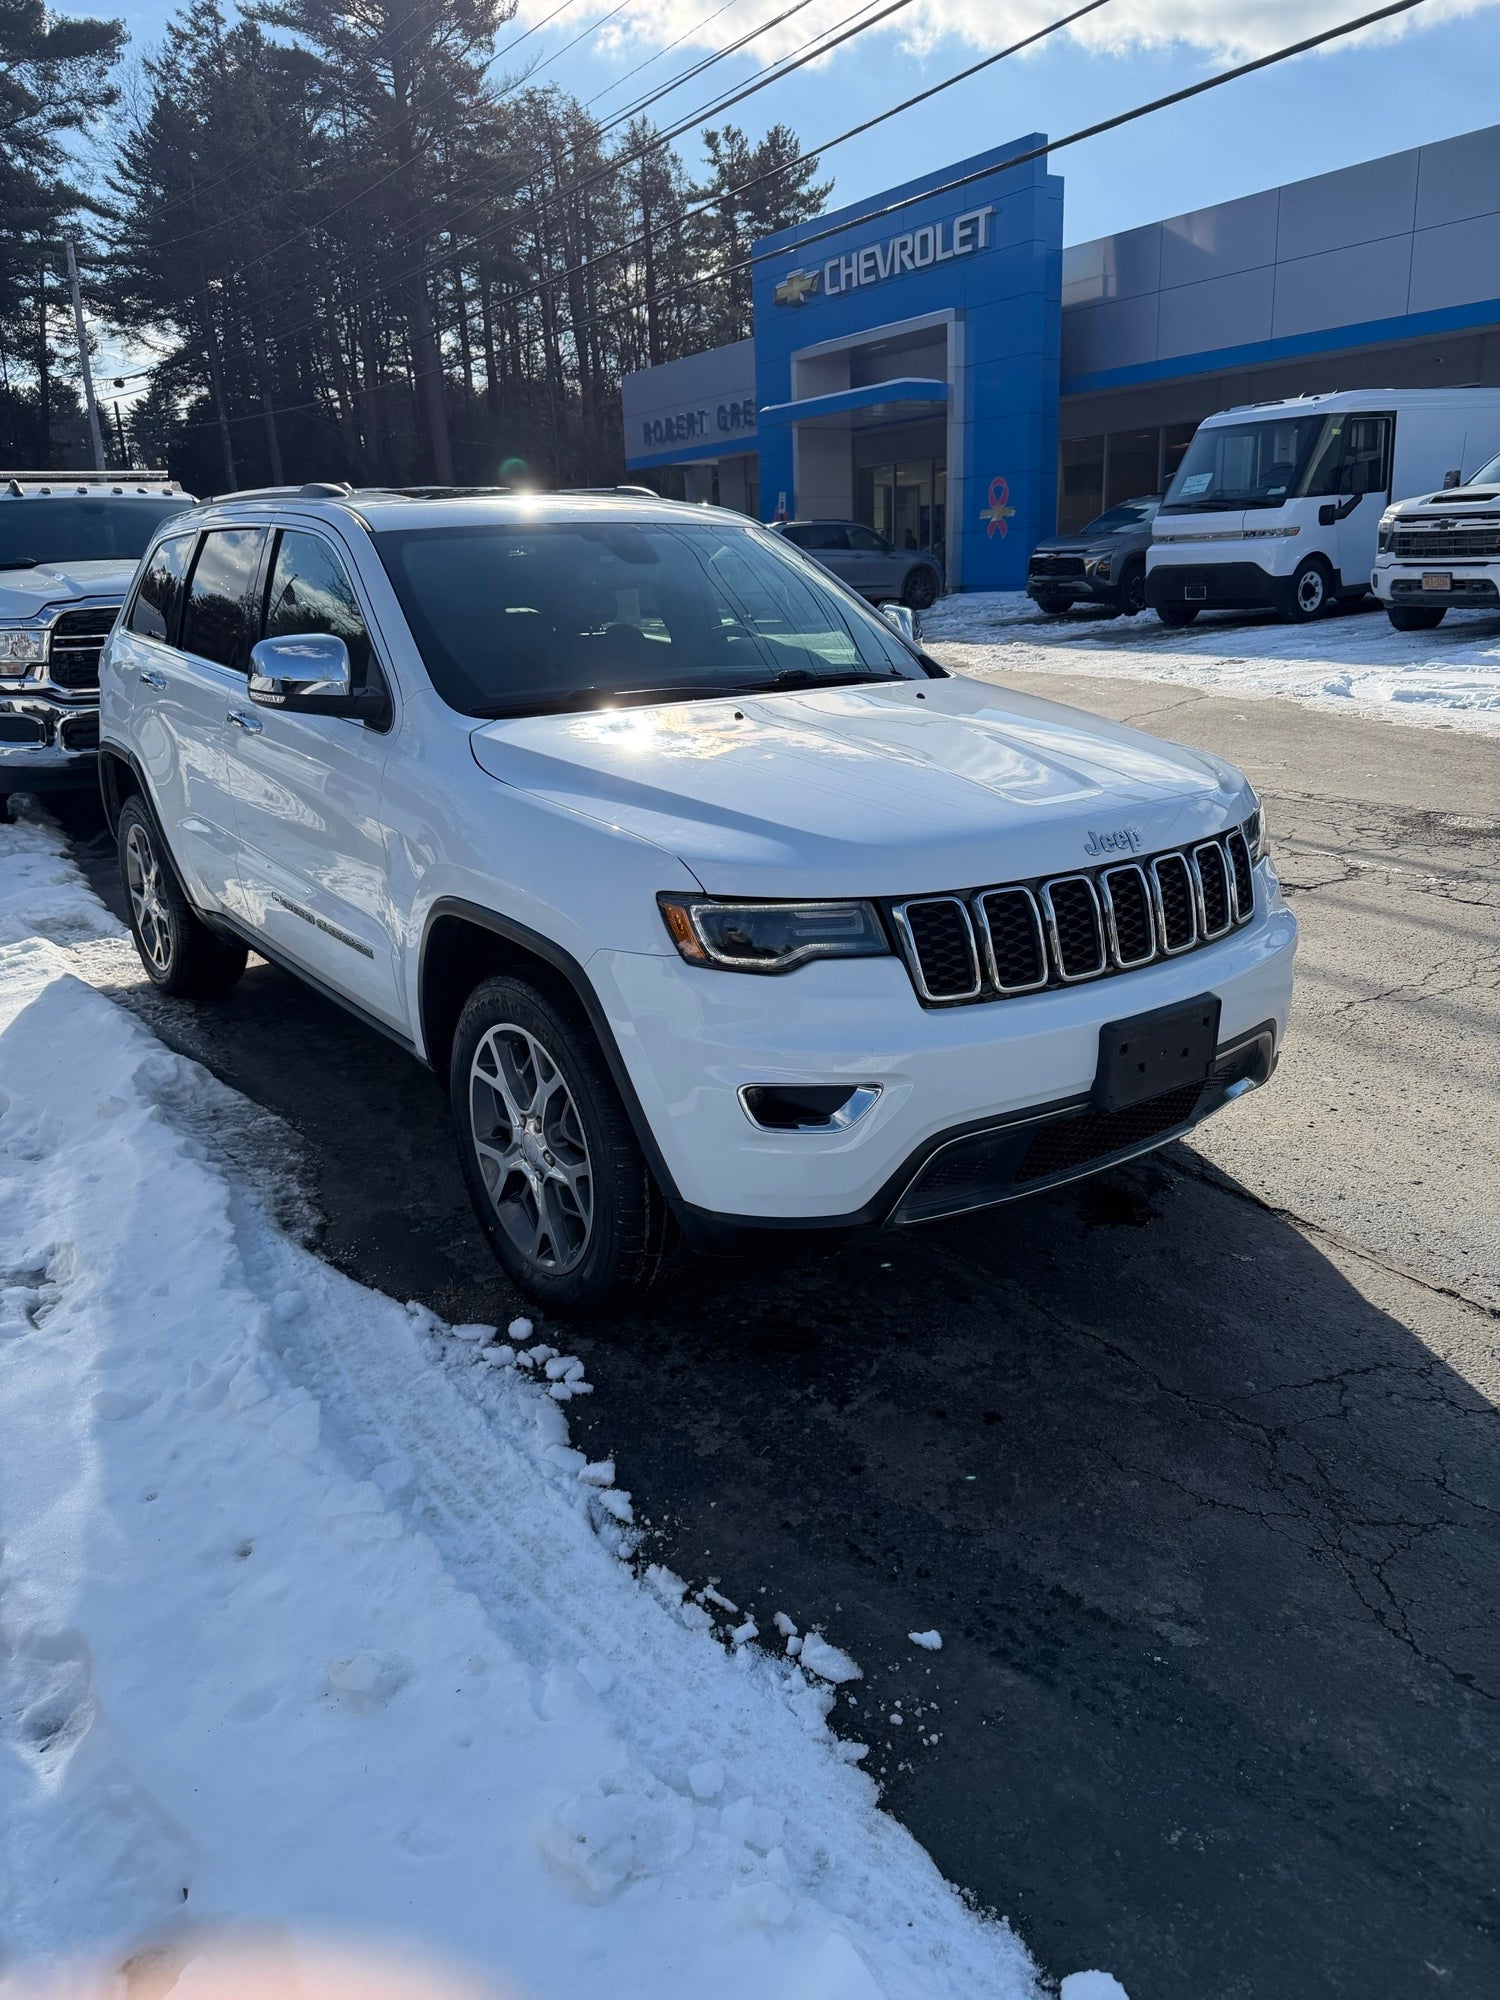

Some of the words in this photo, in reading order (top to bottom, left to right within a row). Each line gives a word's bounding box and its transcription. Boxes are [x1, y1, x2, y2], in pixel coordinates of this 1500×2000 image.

[824, 205, 996, 296] CHEVROLET
[643, 409, 709, 447] ROBERT
[1084, 828, 1142, 857] Jeep
